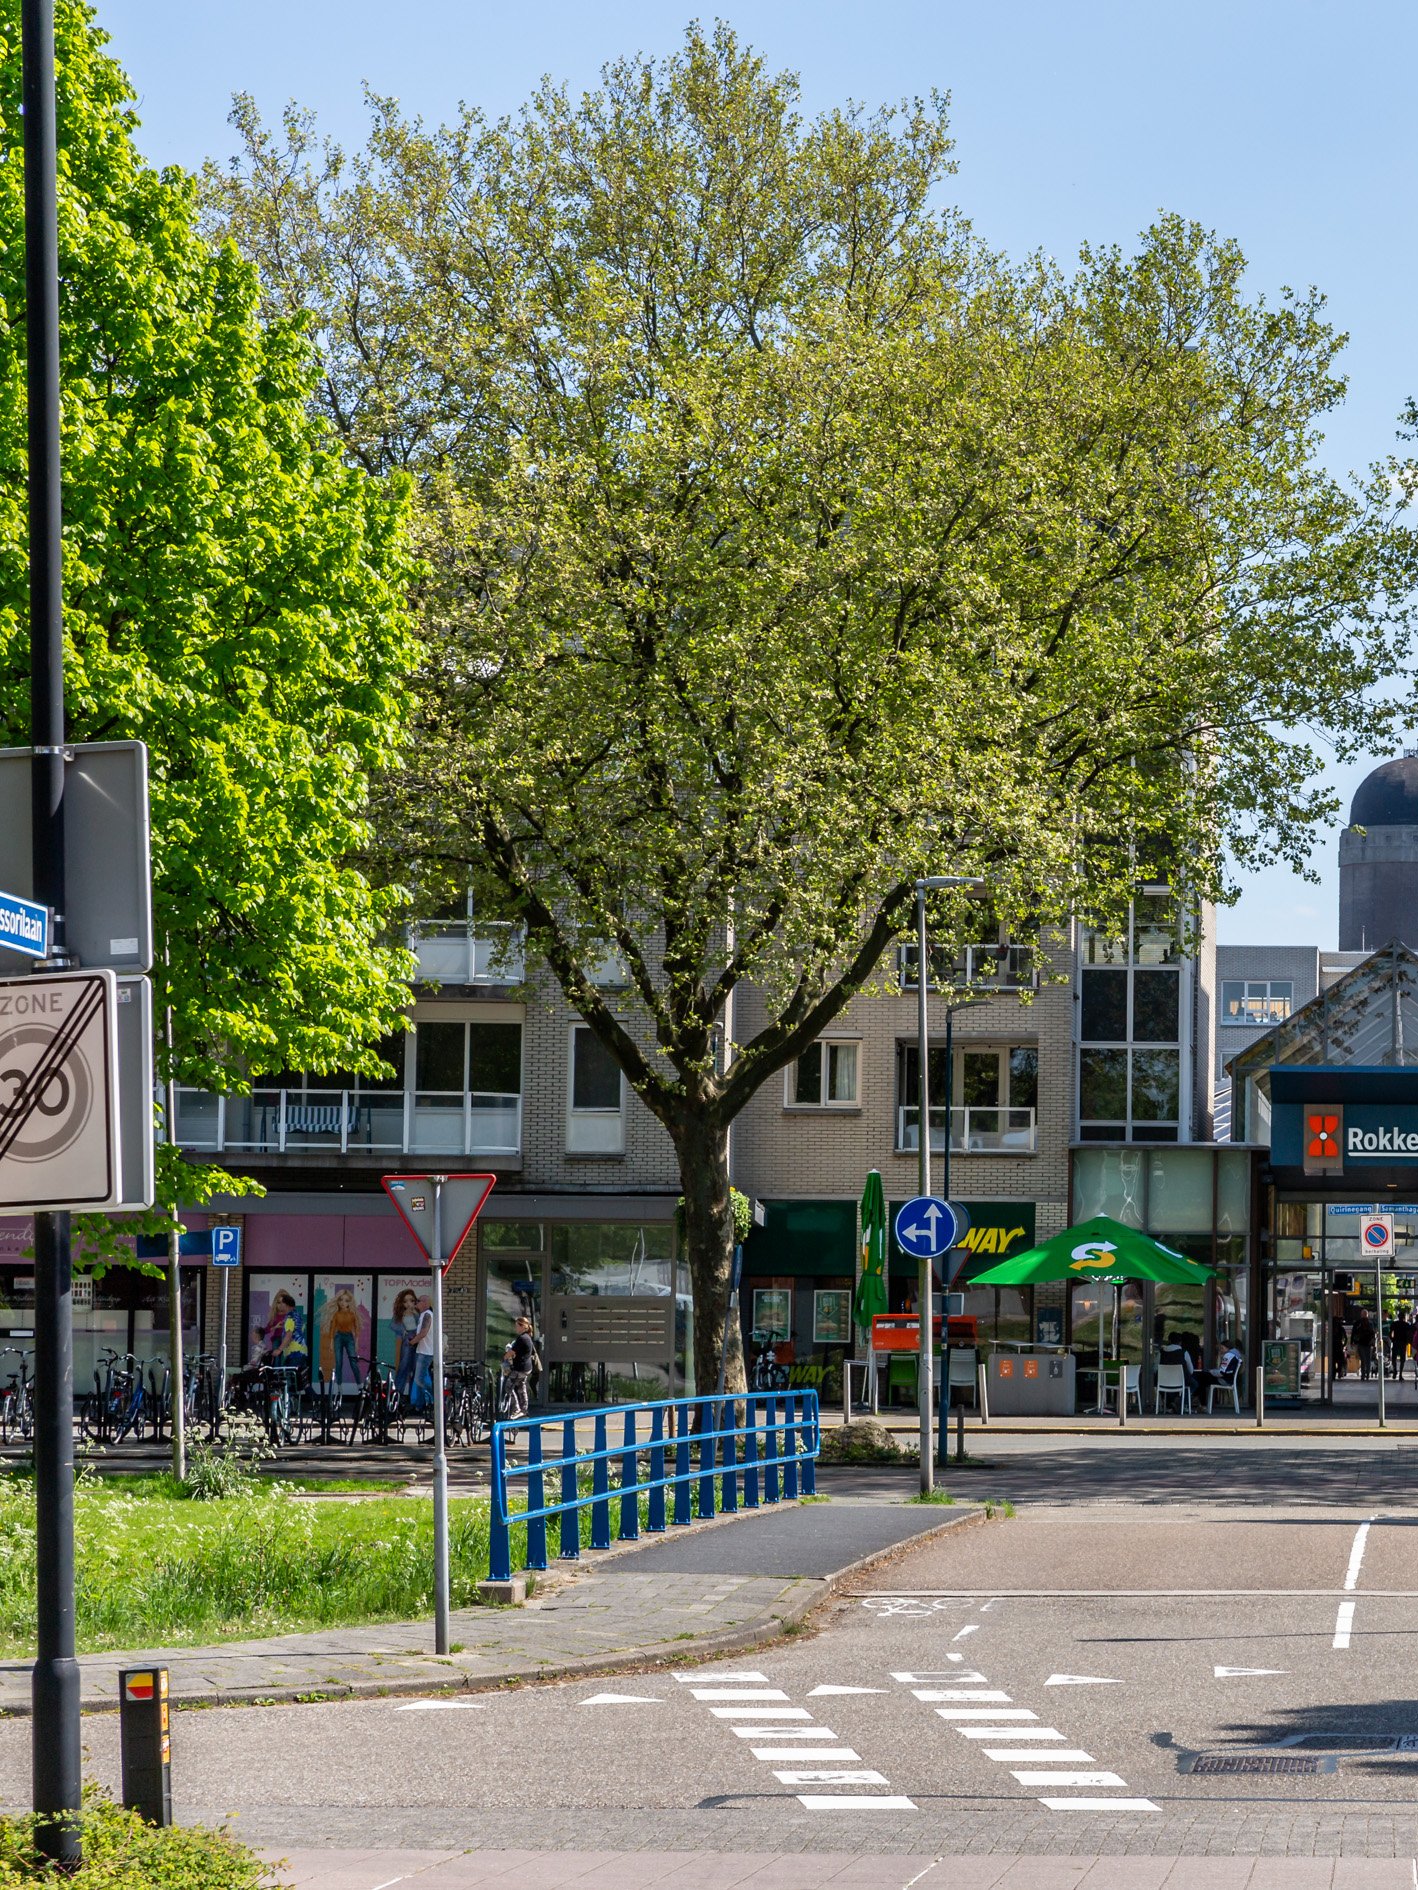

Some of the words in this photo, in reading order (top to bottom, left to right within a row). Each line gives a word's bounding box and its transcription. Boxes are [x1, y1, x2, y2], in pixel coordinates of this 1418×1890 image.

[0, 993, 62, 1015] ZONE
[0, 1067, 69, 1118] 30
[220, 1230, 234, 1249] P
